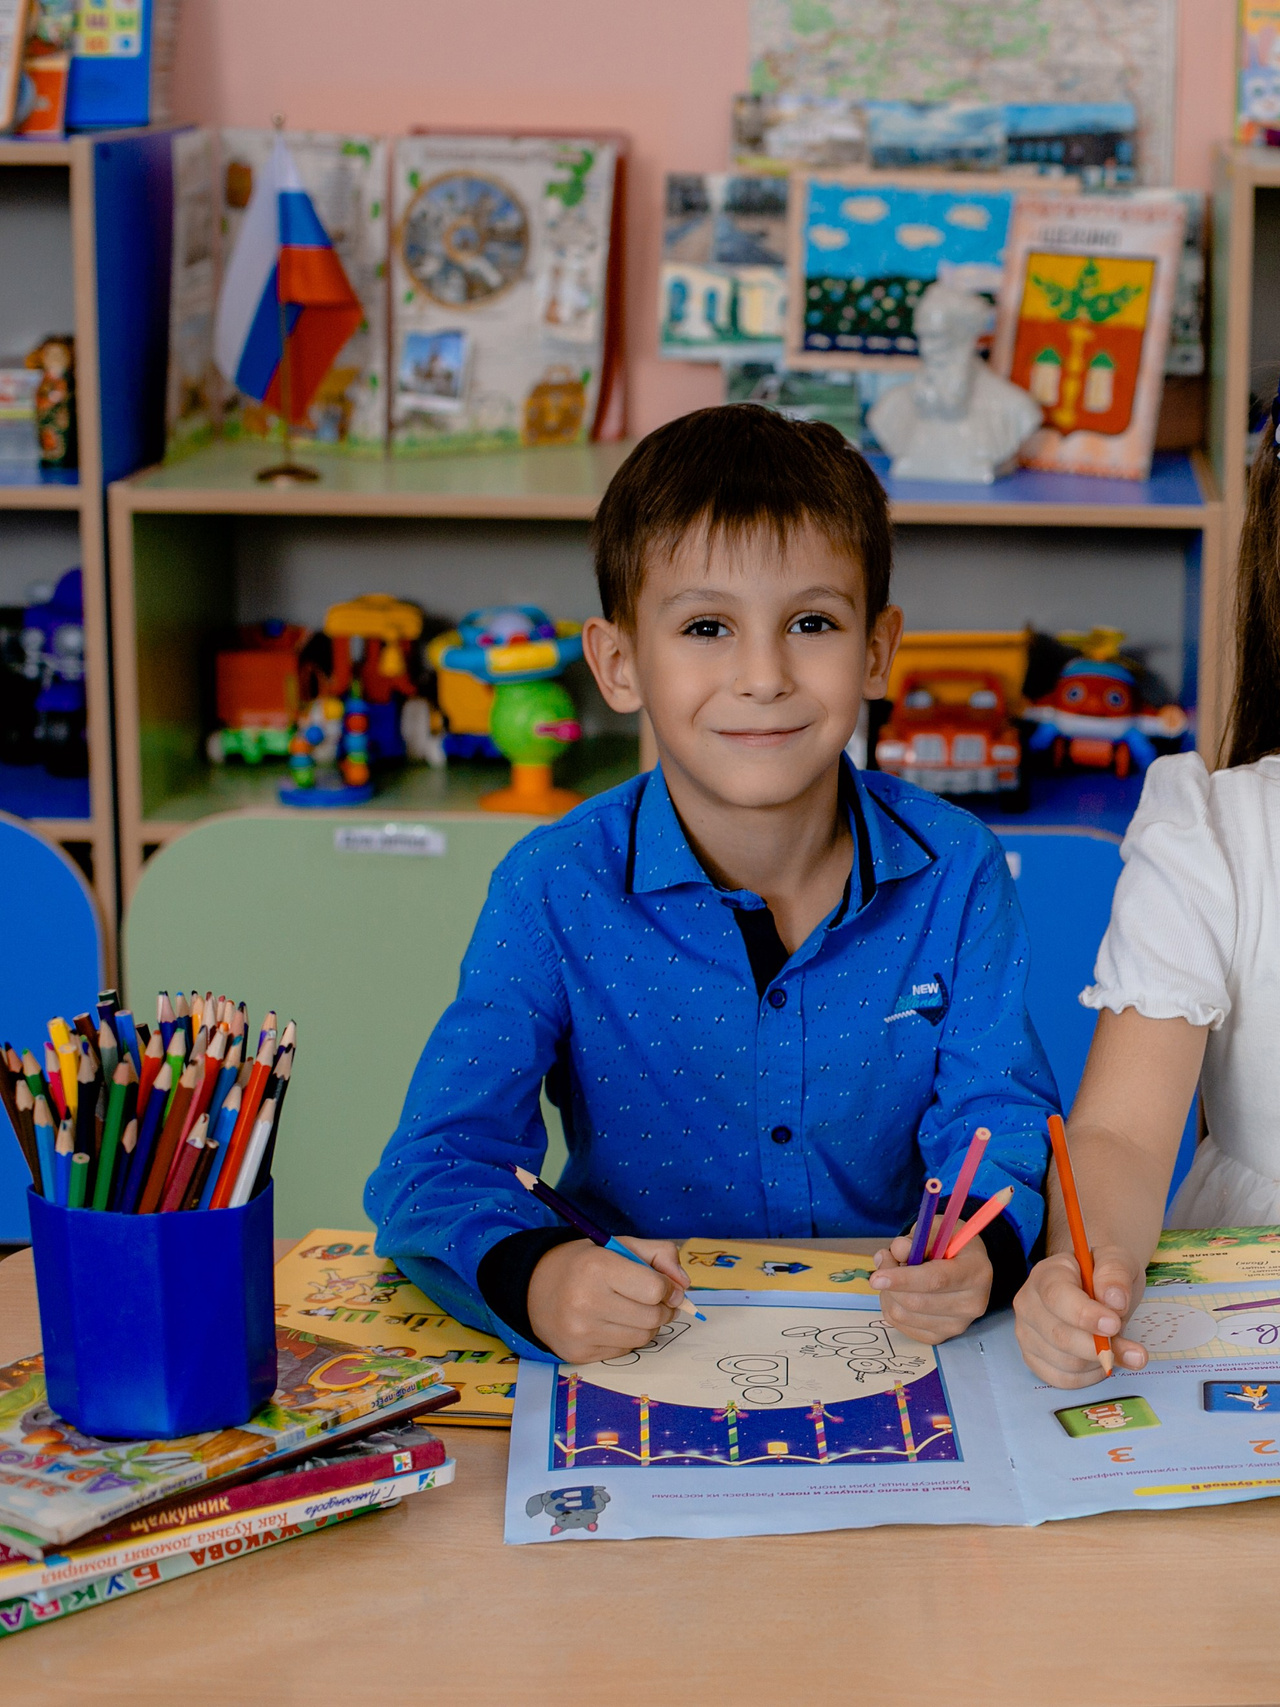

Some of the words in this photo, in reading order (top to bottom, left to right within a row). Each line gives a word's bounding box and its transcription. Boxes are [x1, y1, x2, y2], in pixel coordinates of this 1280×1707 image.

[912, 982, 940, 997] NEW
[1181, 1251, 1228, 1259] василёк
[1117, 1369, 1165, 1378] порядку,
[1107, 1447, 1136, 1463] 3
[1249, 1439, 1280, 1455] 2
[1126, 1467, 1179, 1476] нужными
[1189, 1463, 1244, 1472] соединив
[911, 1479, 960, 1487] дорисуй
[1069, 1470, 1124, 1482] цифрами.
[383, 1484, 396, 1499] Г.
[1203, 1479, 1253, 1489] буквой
[303, 1488, 381, 1519] Александрова
[550, 1485, 597, 1512] В
[258, 1511, 288, 1529] Как
[196, 1519, 253, 1547] Кузька
[122, 1536, 193, 1566] домовят
[188, 1522, 303, 1567] ЖУКОВА
[40, 1555, 118, 1587] помирил
